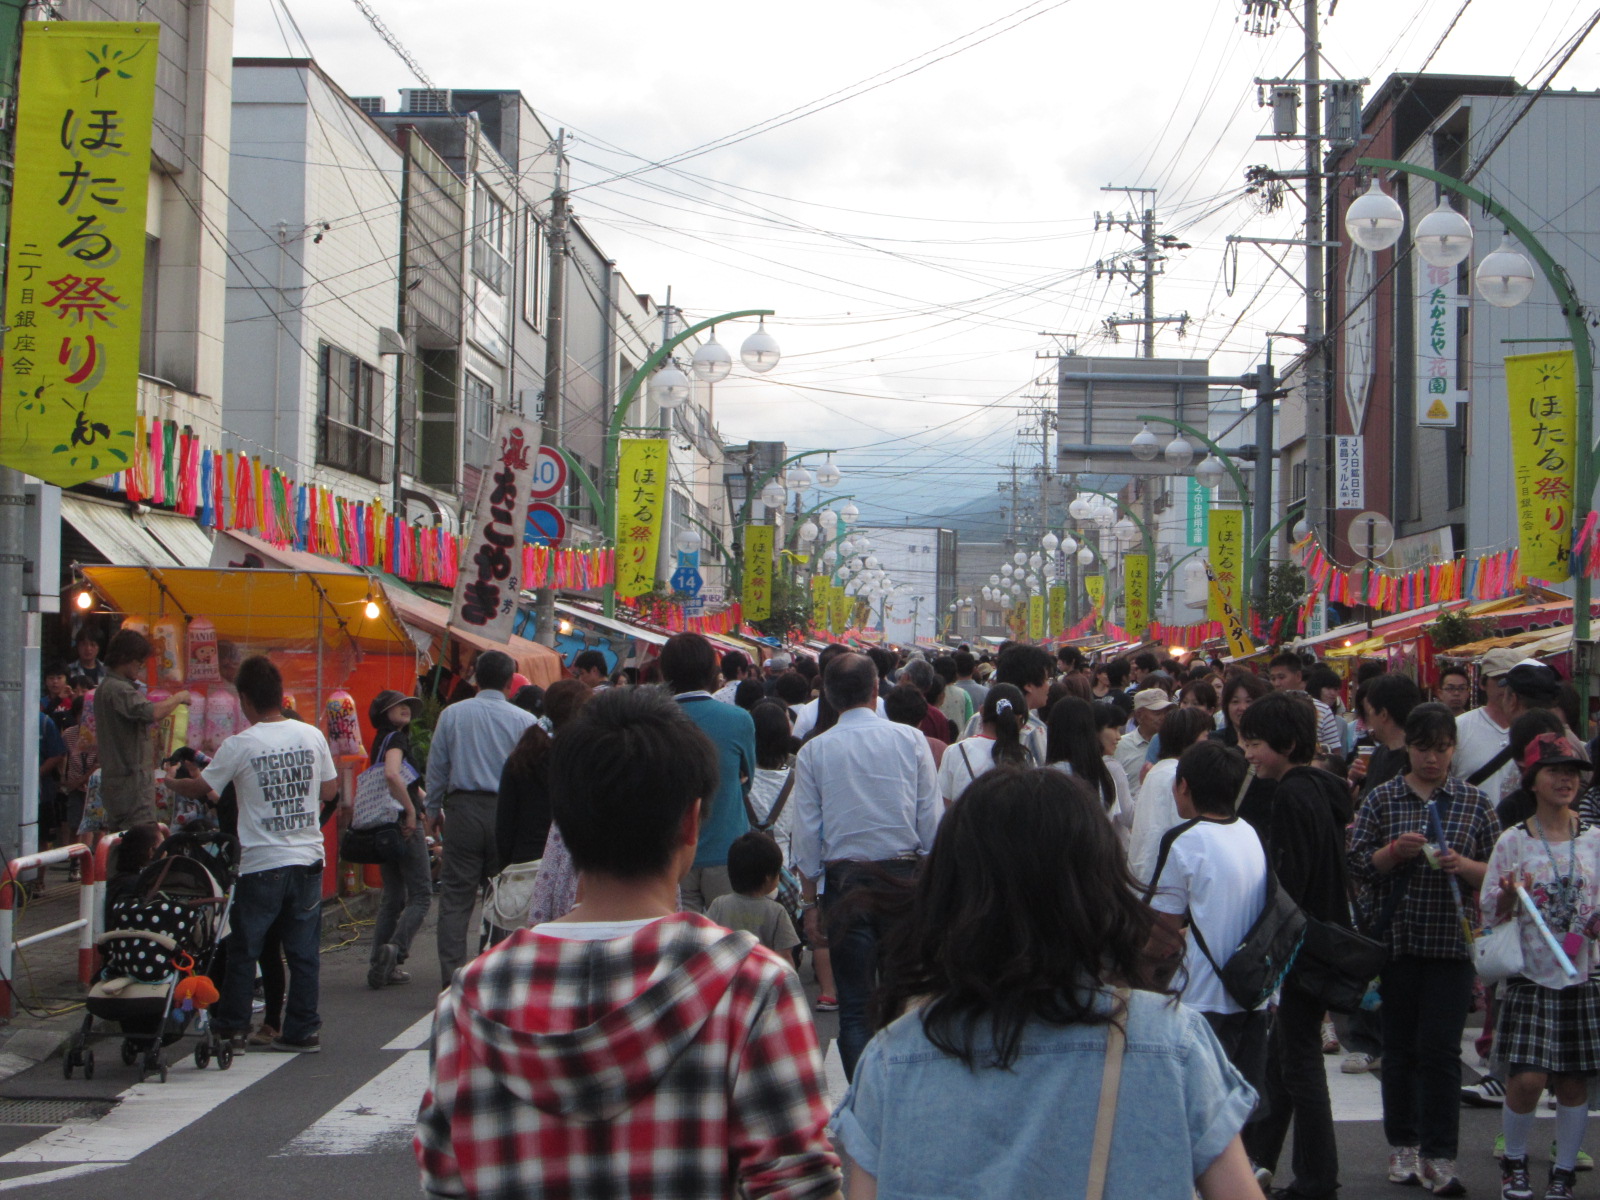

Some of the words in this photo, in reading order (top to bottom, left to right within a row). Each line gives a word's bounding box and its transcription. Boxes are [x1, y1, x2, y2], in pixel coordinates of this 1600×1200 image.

[41, 108, 127, 386] ほたる祭り
[12, 243, 43, 375] 二丁目銀座会
[1529, 394, 1572, 532] ほたる祭り
[627, 468, 656, 564] ほたる祭り
[678, 576, 696, 588] 14
[250, 749, 316, 772] VICIOUS
[257, 765, 314, 788] BRAND
[262, 781, 311, 802] KNOW
[272, 797, 306, 816] THE
[261, 811, 316, 832] TRUTH
